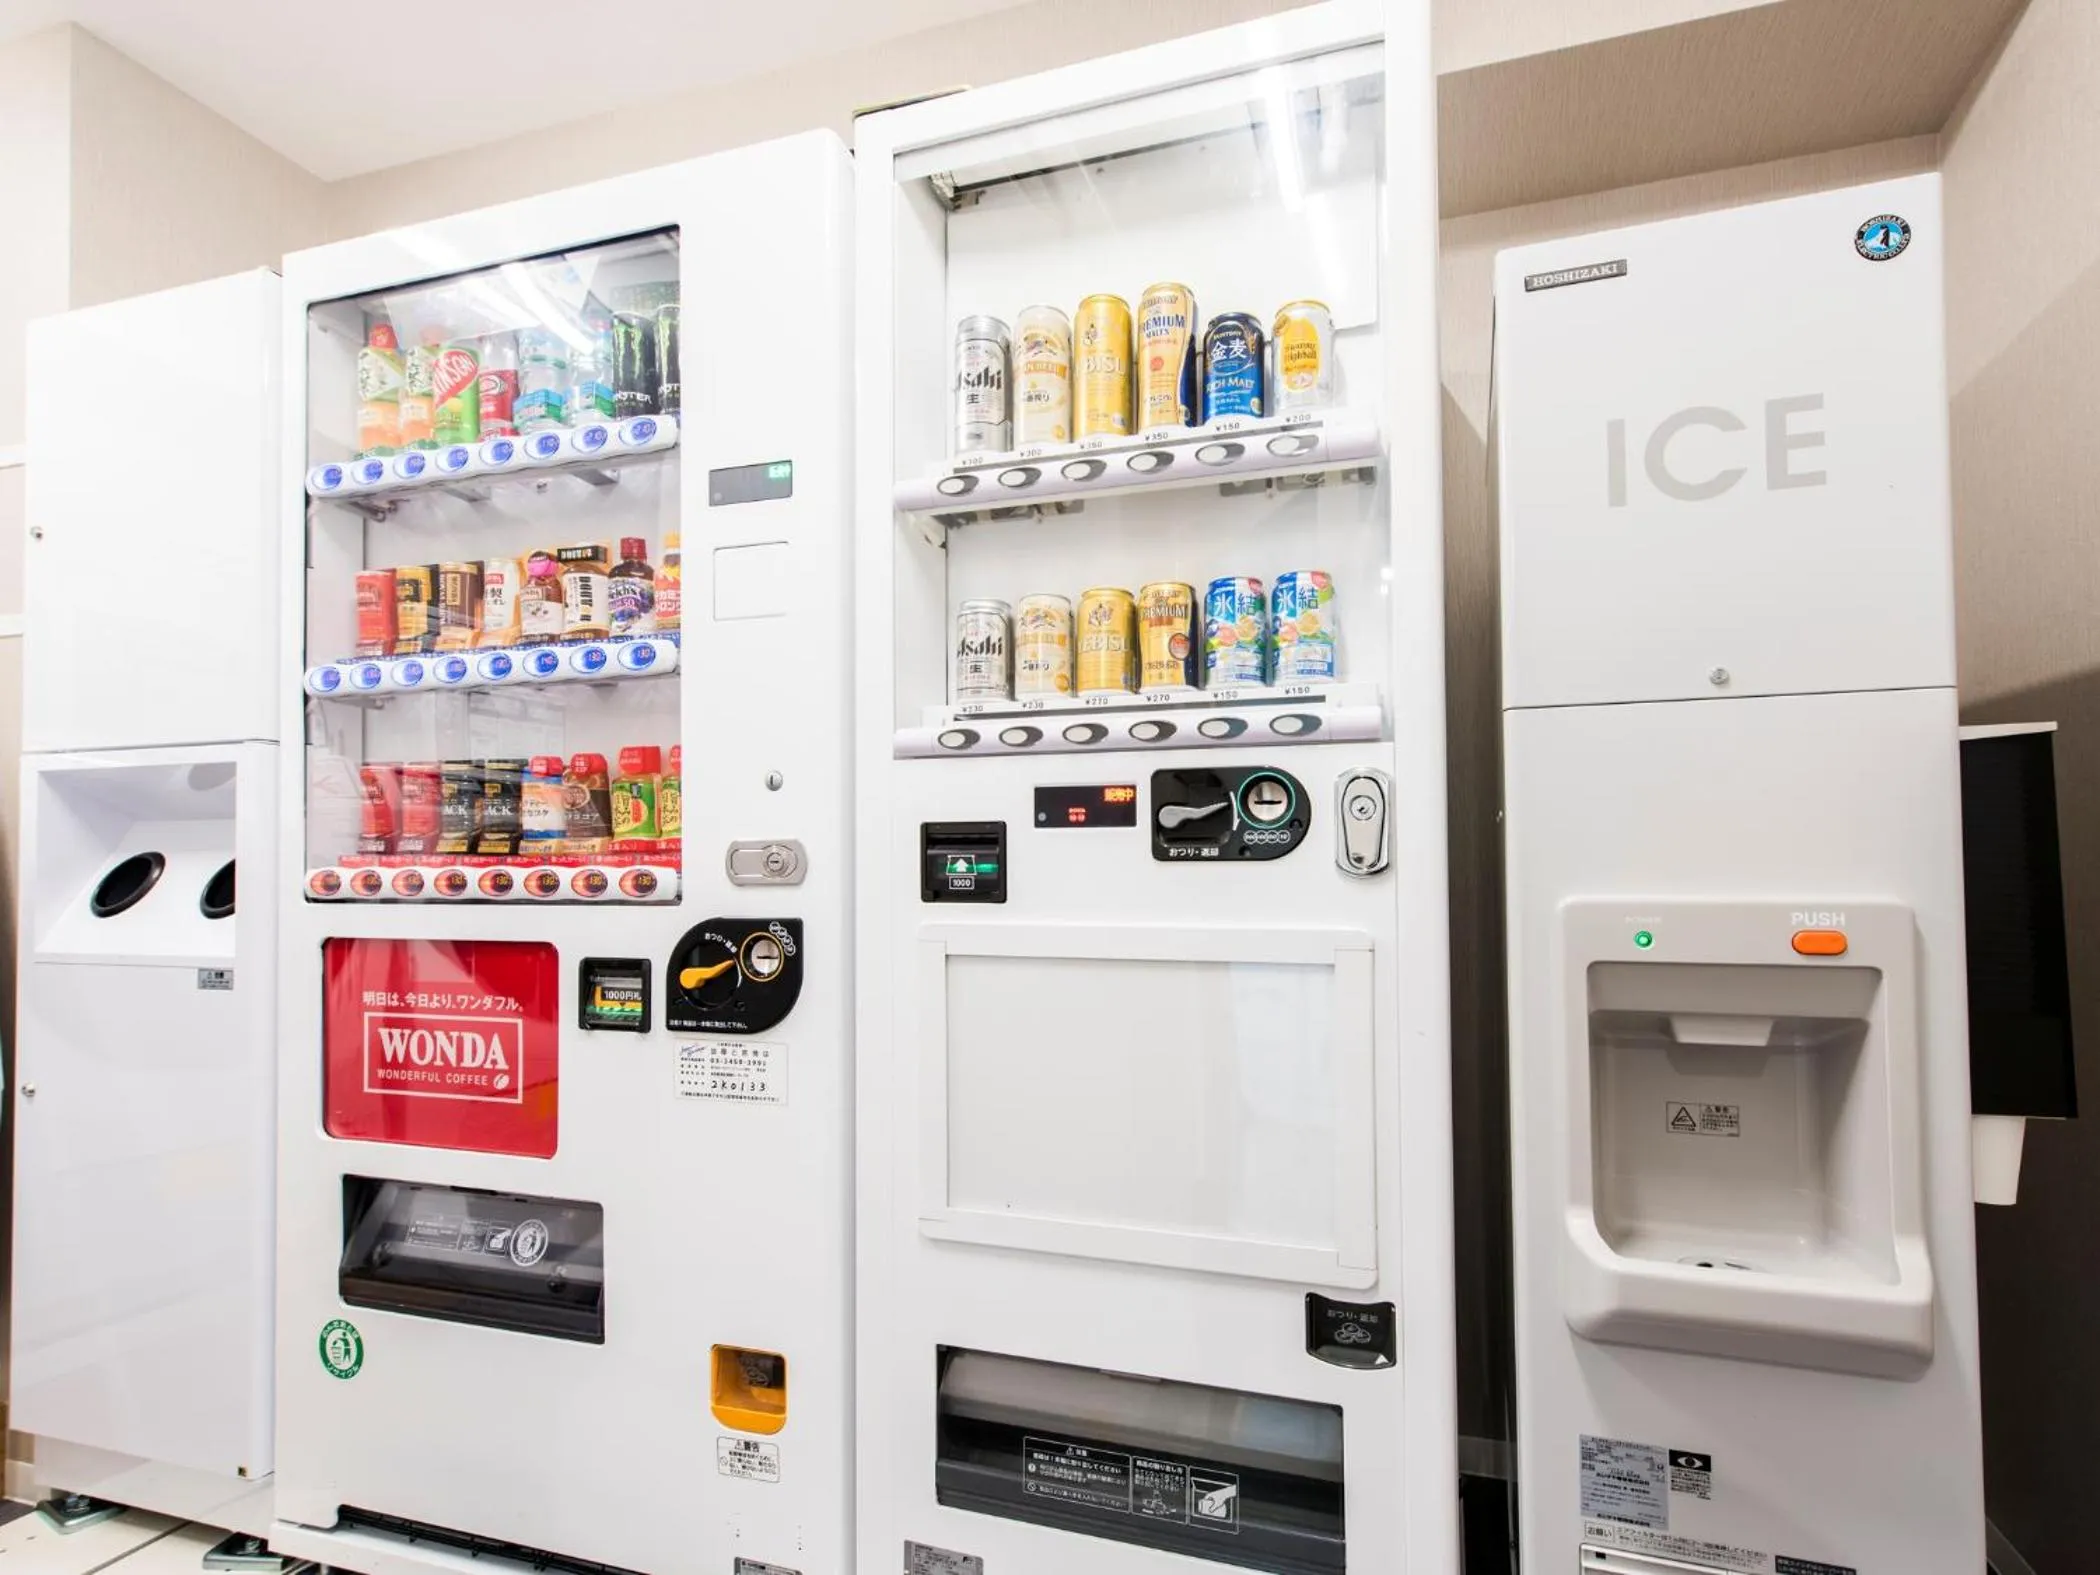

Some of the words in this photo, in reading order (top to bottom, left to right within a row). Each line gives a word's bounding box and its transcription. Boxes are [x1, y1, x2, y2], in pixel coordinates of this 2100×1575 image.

[1532, 262, 1619, 288] HOSHIZAKI
[1210, 337, 1248, 362] 金麦
[1227, 377, 1256, 391] MALT
[966, 393, 980, 404] 生
[1606, 392, 1828, 508] ICE
[1213, 591, 1257, 616] 氷結
[1277, 586, 1319, 614] 氷結
[1146, 694, 1170, 702] ¥270
[953, 878, 971, 888] 1000
[1791, 911, 1846, 927] PUSH
[361, 990, 524, 1013] 明日は、今日より、ワンダフル。
[377, 1027, 510, 1070] WONDA
[376, 1068, 441, 1084] WONDERFUL
[446, 1072, 489, 1086] COFFEE
